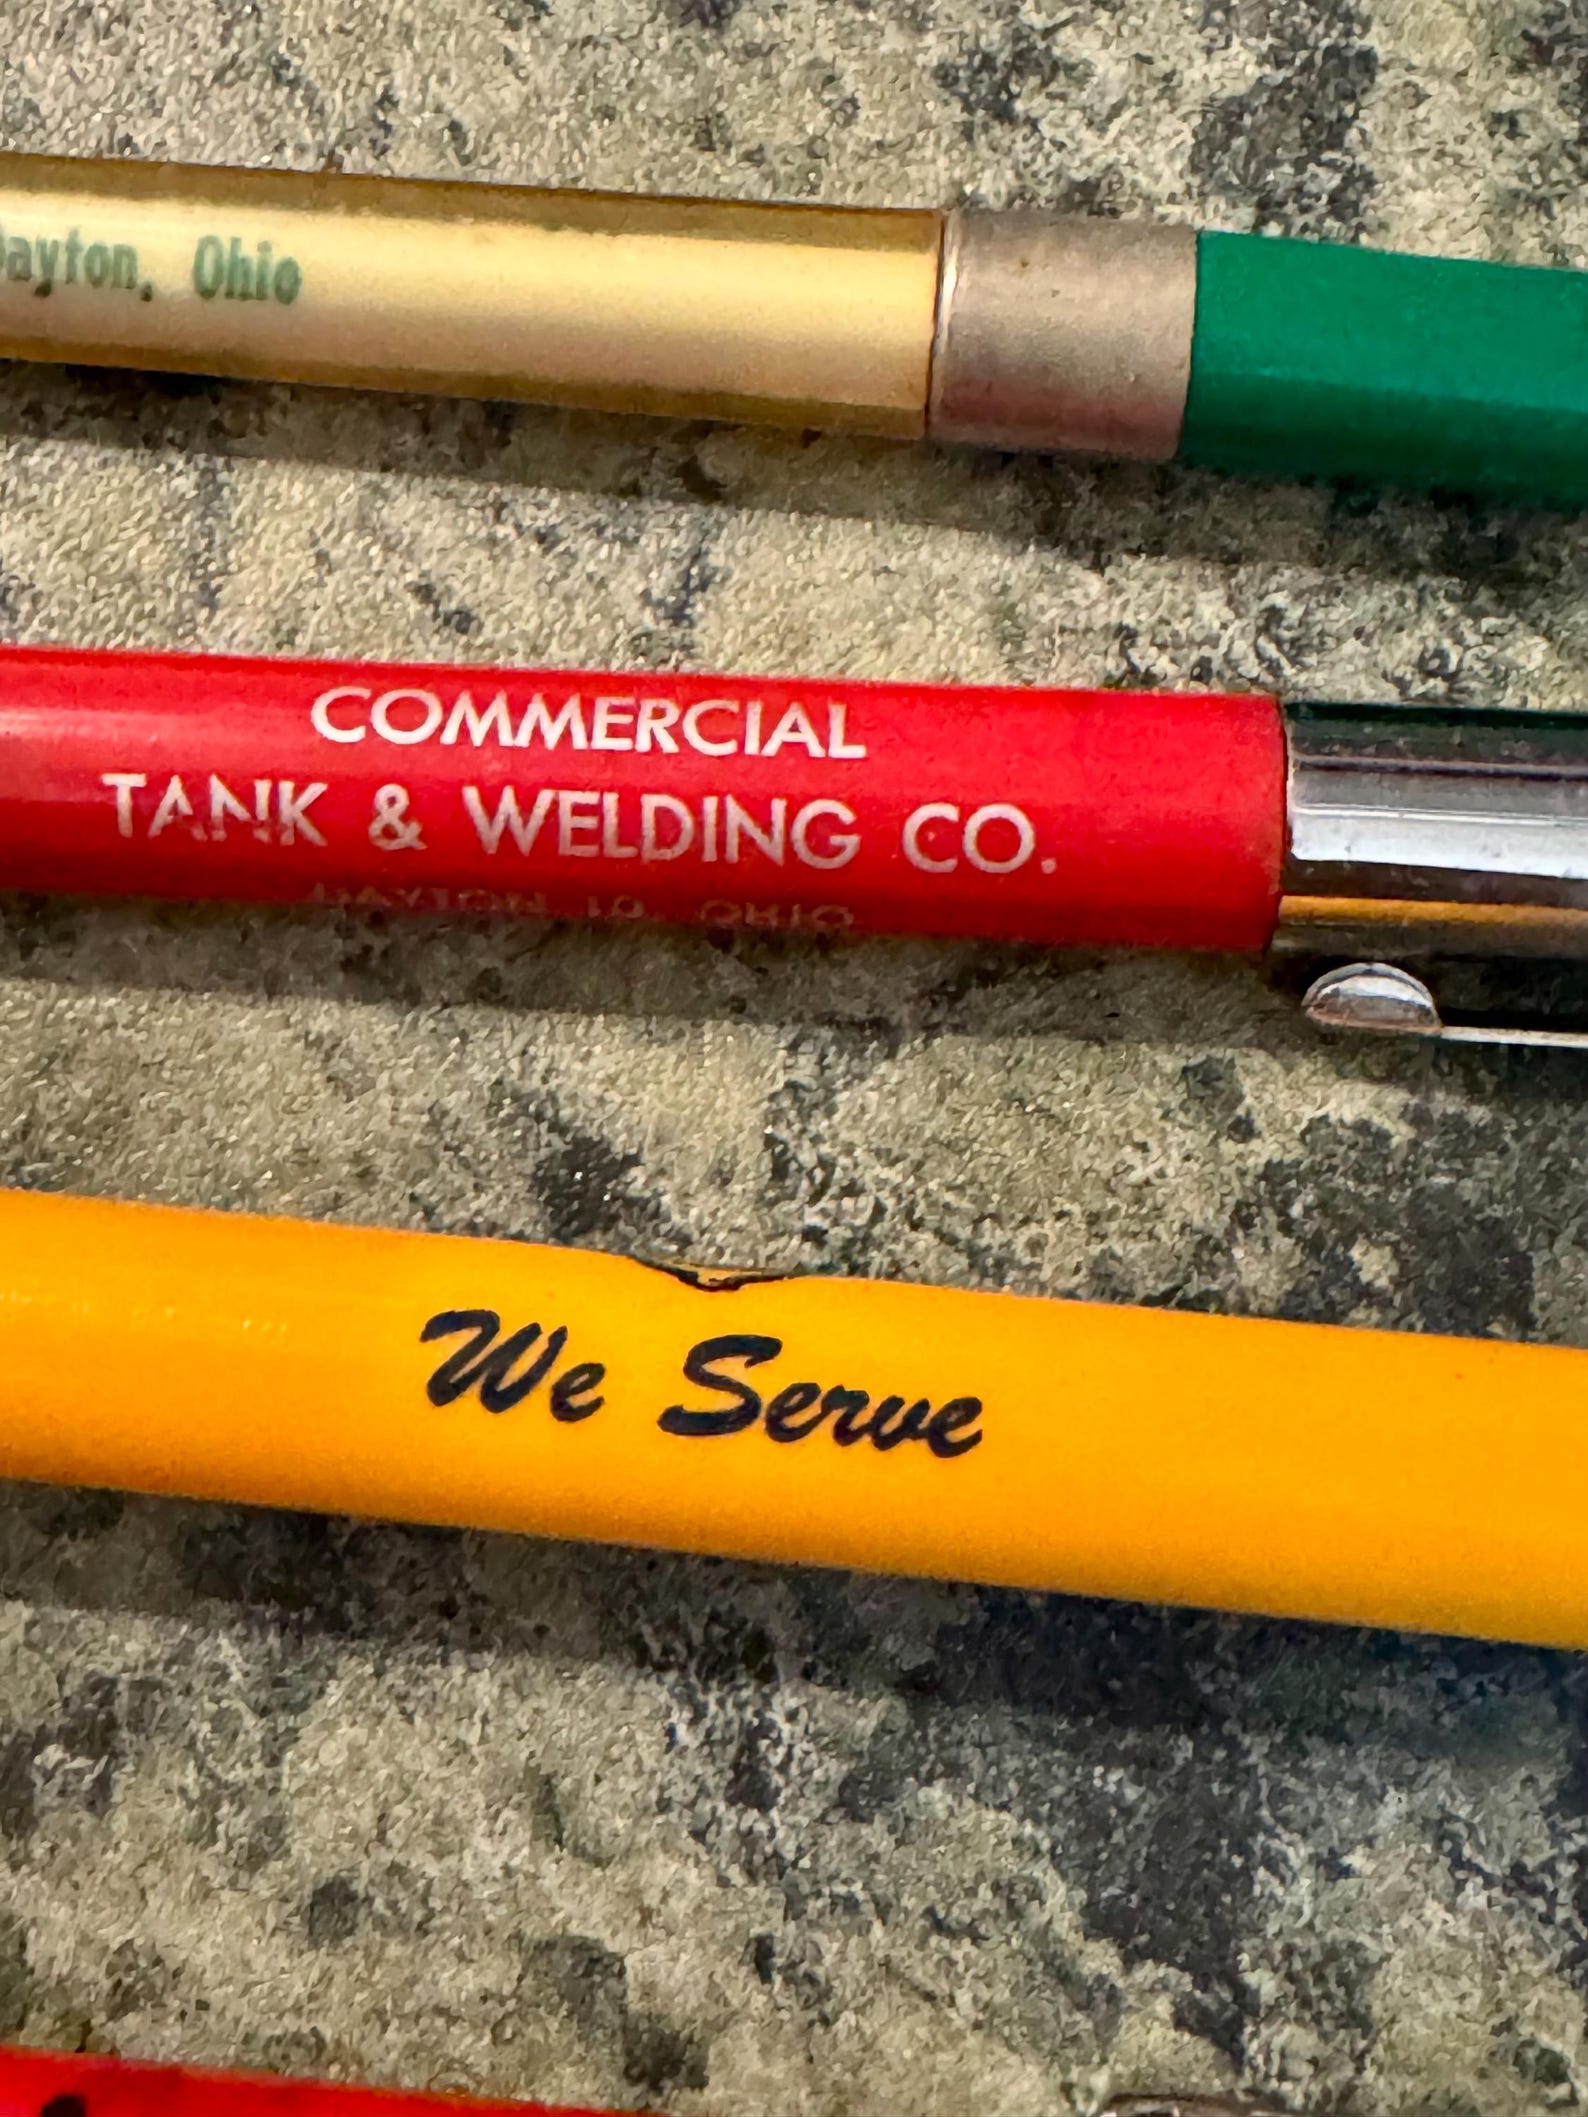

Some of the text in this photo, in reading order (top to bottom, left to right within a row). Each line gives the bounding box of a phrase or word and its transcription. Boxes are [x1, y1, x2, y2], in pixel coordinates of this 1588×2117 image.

[193, 234, 302, 305] Ohio
[310, 685, 867, 759] COMMERCIAL
[101, 772, 1057, 874] TANK & WELDING CO.
[699, 899, 854, 930] OHIO
[419, 1308, 983, 1459] We Serve
